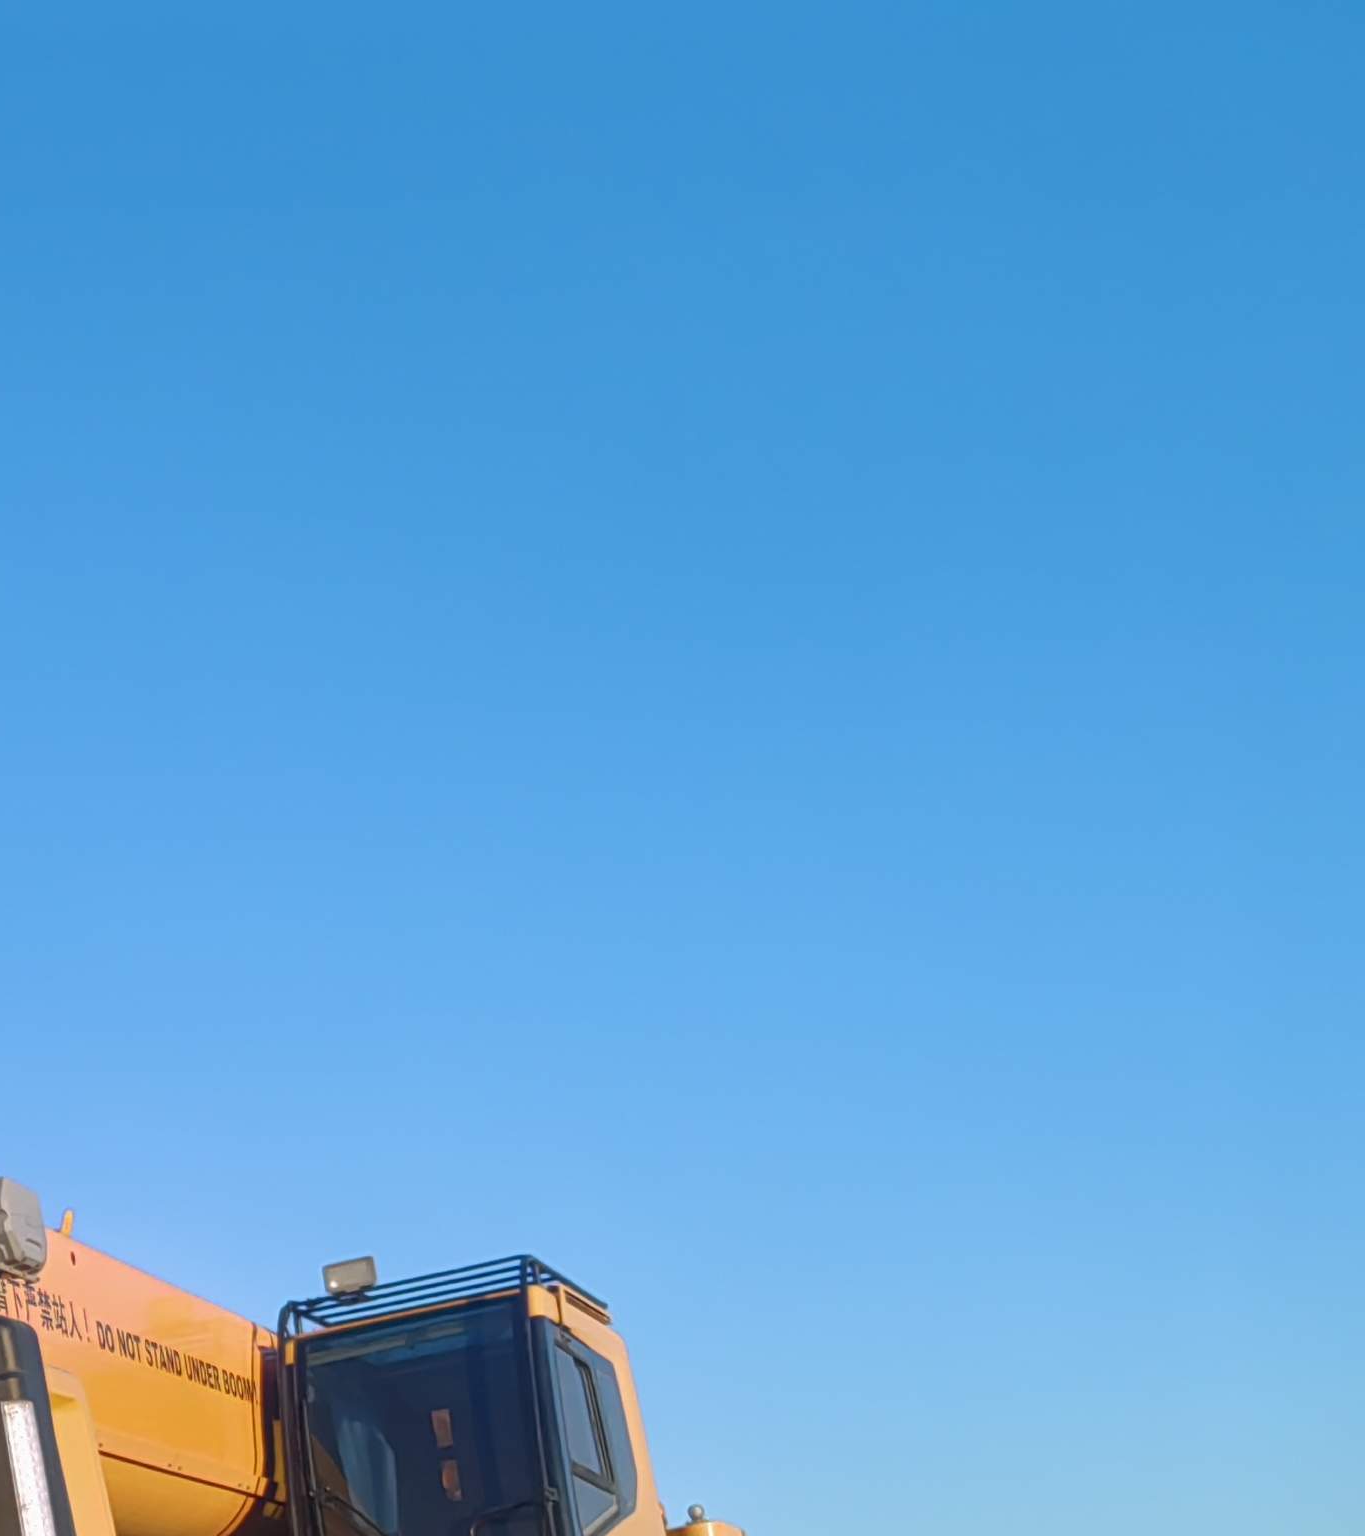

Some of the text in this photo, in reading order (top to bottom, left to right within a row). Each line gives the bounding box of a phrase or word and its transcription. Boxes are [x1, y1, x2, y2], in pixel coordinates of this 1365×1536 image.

[95, 1320, 115, 1352] DO
[118, 1328, 142, 1364] NOT
[144, 1339, 183, 1377] STAND
[184, 1354, 221, 1392] UNDER
